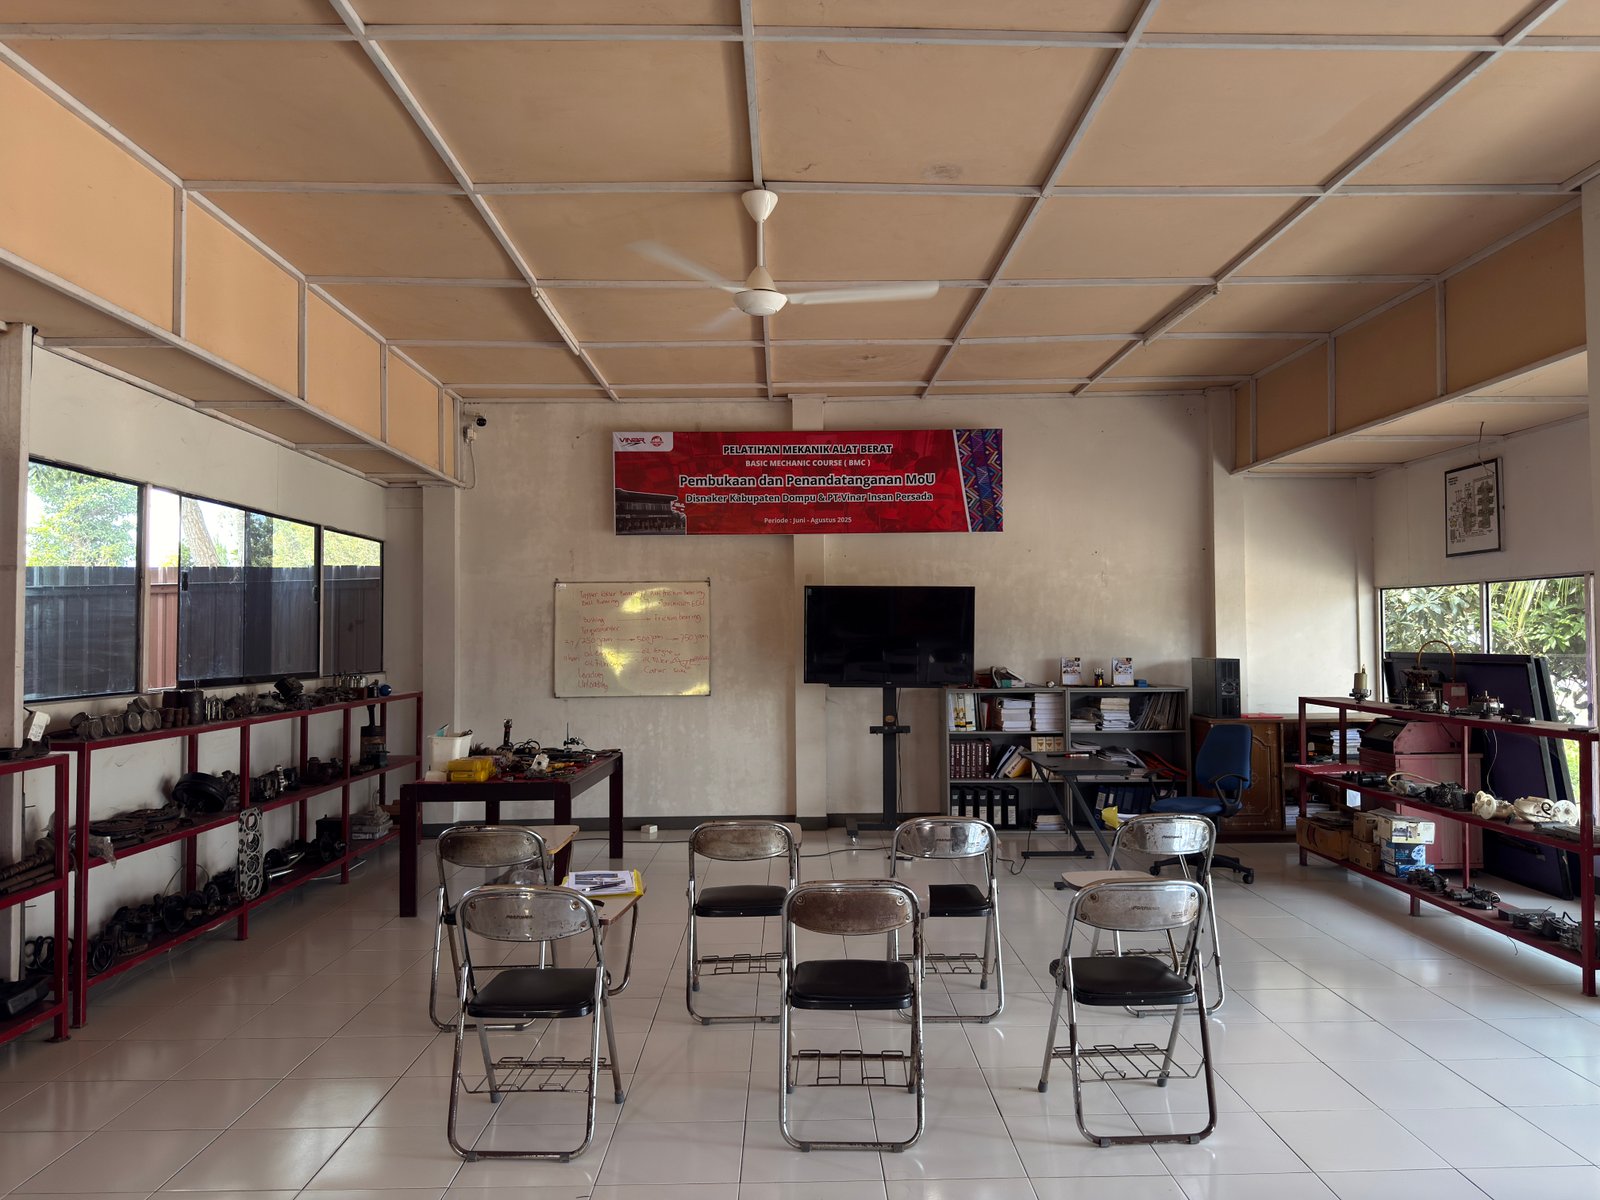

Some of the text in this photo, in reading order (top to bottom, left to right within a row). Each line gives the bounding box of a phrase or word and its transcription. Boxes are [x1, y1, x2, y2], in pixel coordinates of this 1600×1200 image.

[723, 444, 893, 455] PELATIHAN MEKANIK ALAT BERAT
[769, 459, 811, 467] MECHANIC
[812, 459, 843, 467] COURSE
[848, 459, 866, 467] BMC
[679, 473, 936, 488] Pembukaan dan Penandatanganan MoU
[685, 493, 728, 502] Disnaker
[729, 493, 781, 504] Kabupaten
[782, 493, 817, 504] Dompu
[818, 493, 827, 502] &
[867, 492, 894, 502] Insan
[895, 492, 933, 502] Persada
[792, 517, 806, 525] Juni
[810, 517, 836, 525] Agustus
[837, 516, 852, 524] 2025
